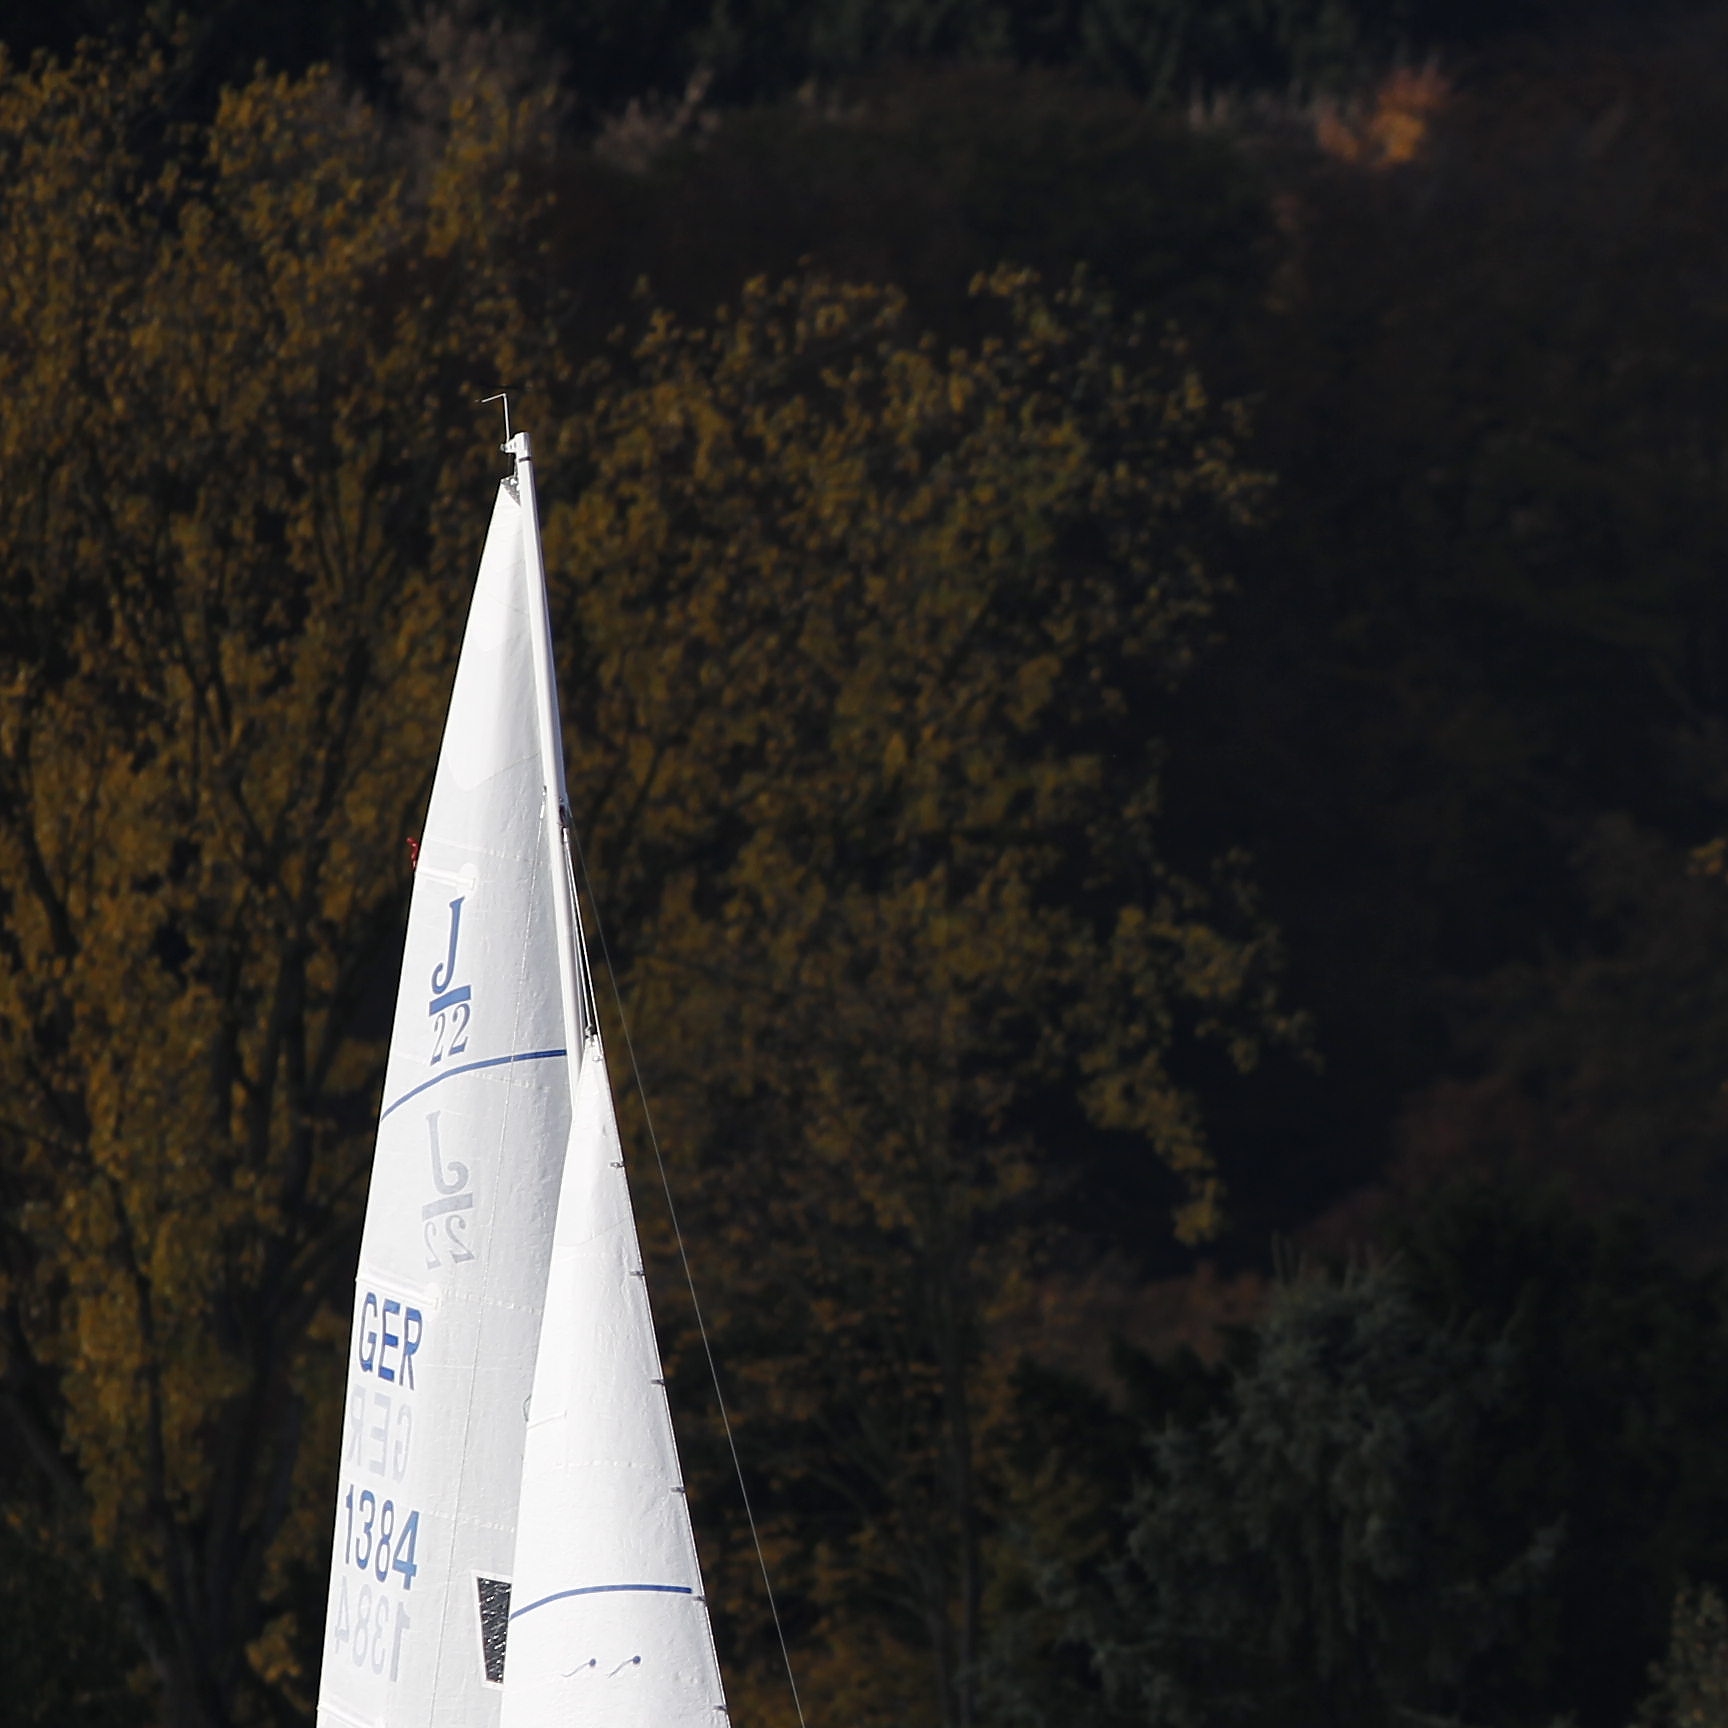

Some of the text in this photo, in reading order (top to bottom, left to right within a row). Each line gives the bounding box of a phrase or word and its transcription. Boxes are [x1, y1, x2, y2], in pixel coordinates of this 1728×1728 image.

[431, 897, 464, 995] J
[431, 1004, 470, 1065] 22
[359, 1292, 423, 1389] GER
[344, 1486, 418, 1590] 1384
